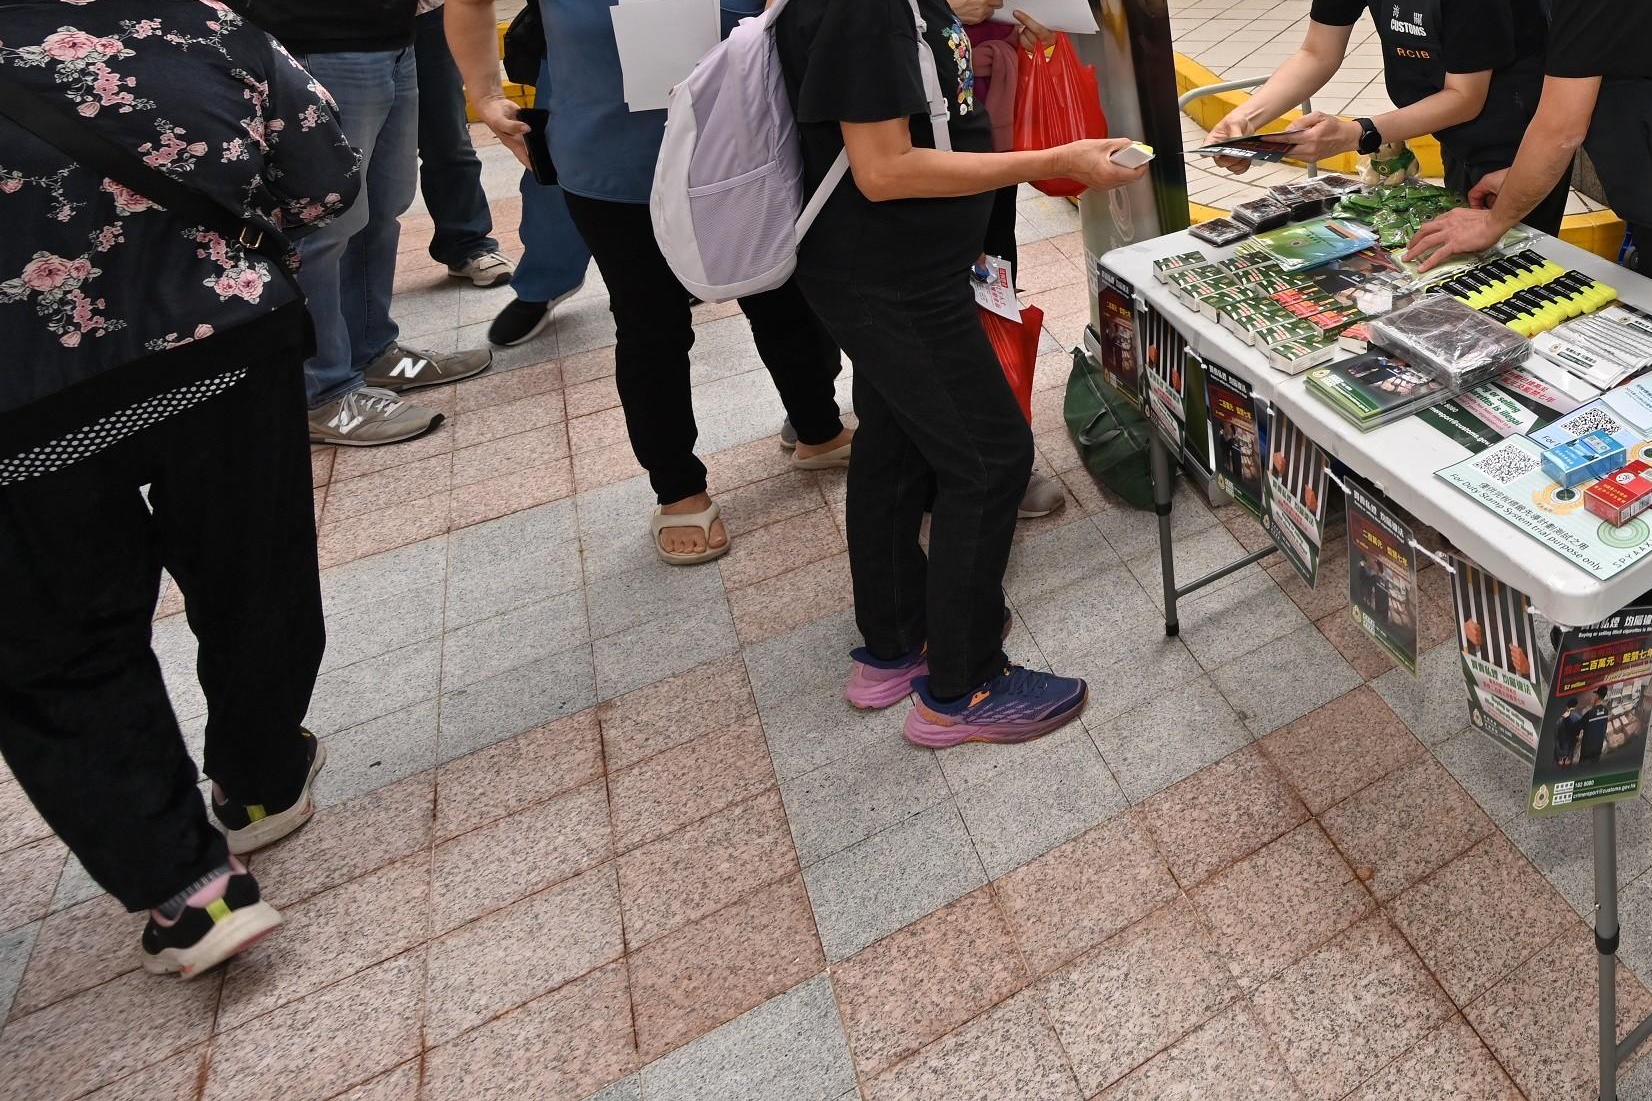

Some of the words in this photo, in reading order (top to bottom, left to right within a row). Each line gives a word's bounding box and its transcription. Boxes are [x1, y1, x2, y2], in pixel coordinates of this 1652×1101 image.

[1390, 18, 1427, 37] CUSTOMS
[1396, 47, 1430, 59] RCIB
[389, 357, 428, 379] N
[1541, 434, 1555, 444] For
[1449, 472, 1463, 483] For
[1463, 479, 1479, 495] Duty
[1478, 490, 1505, 511] Stamp
[1503, 505, 1533, 528] System
[1531, 523, 1551, 539] trial
[1549, 534, 1584, 559] purpose
[1582, 555, 1604, 571] only
